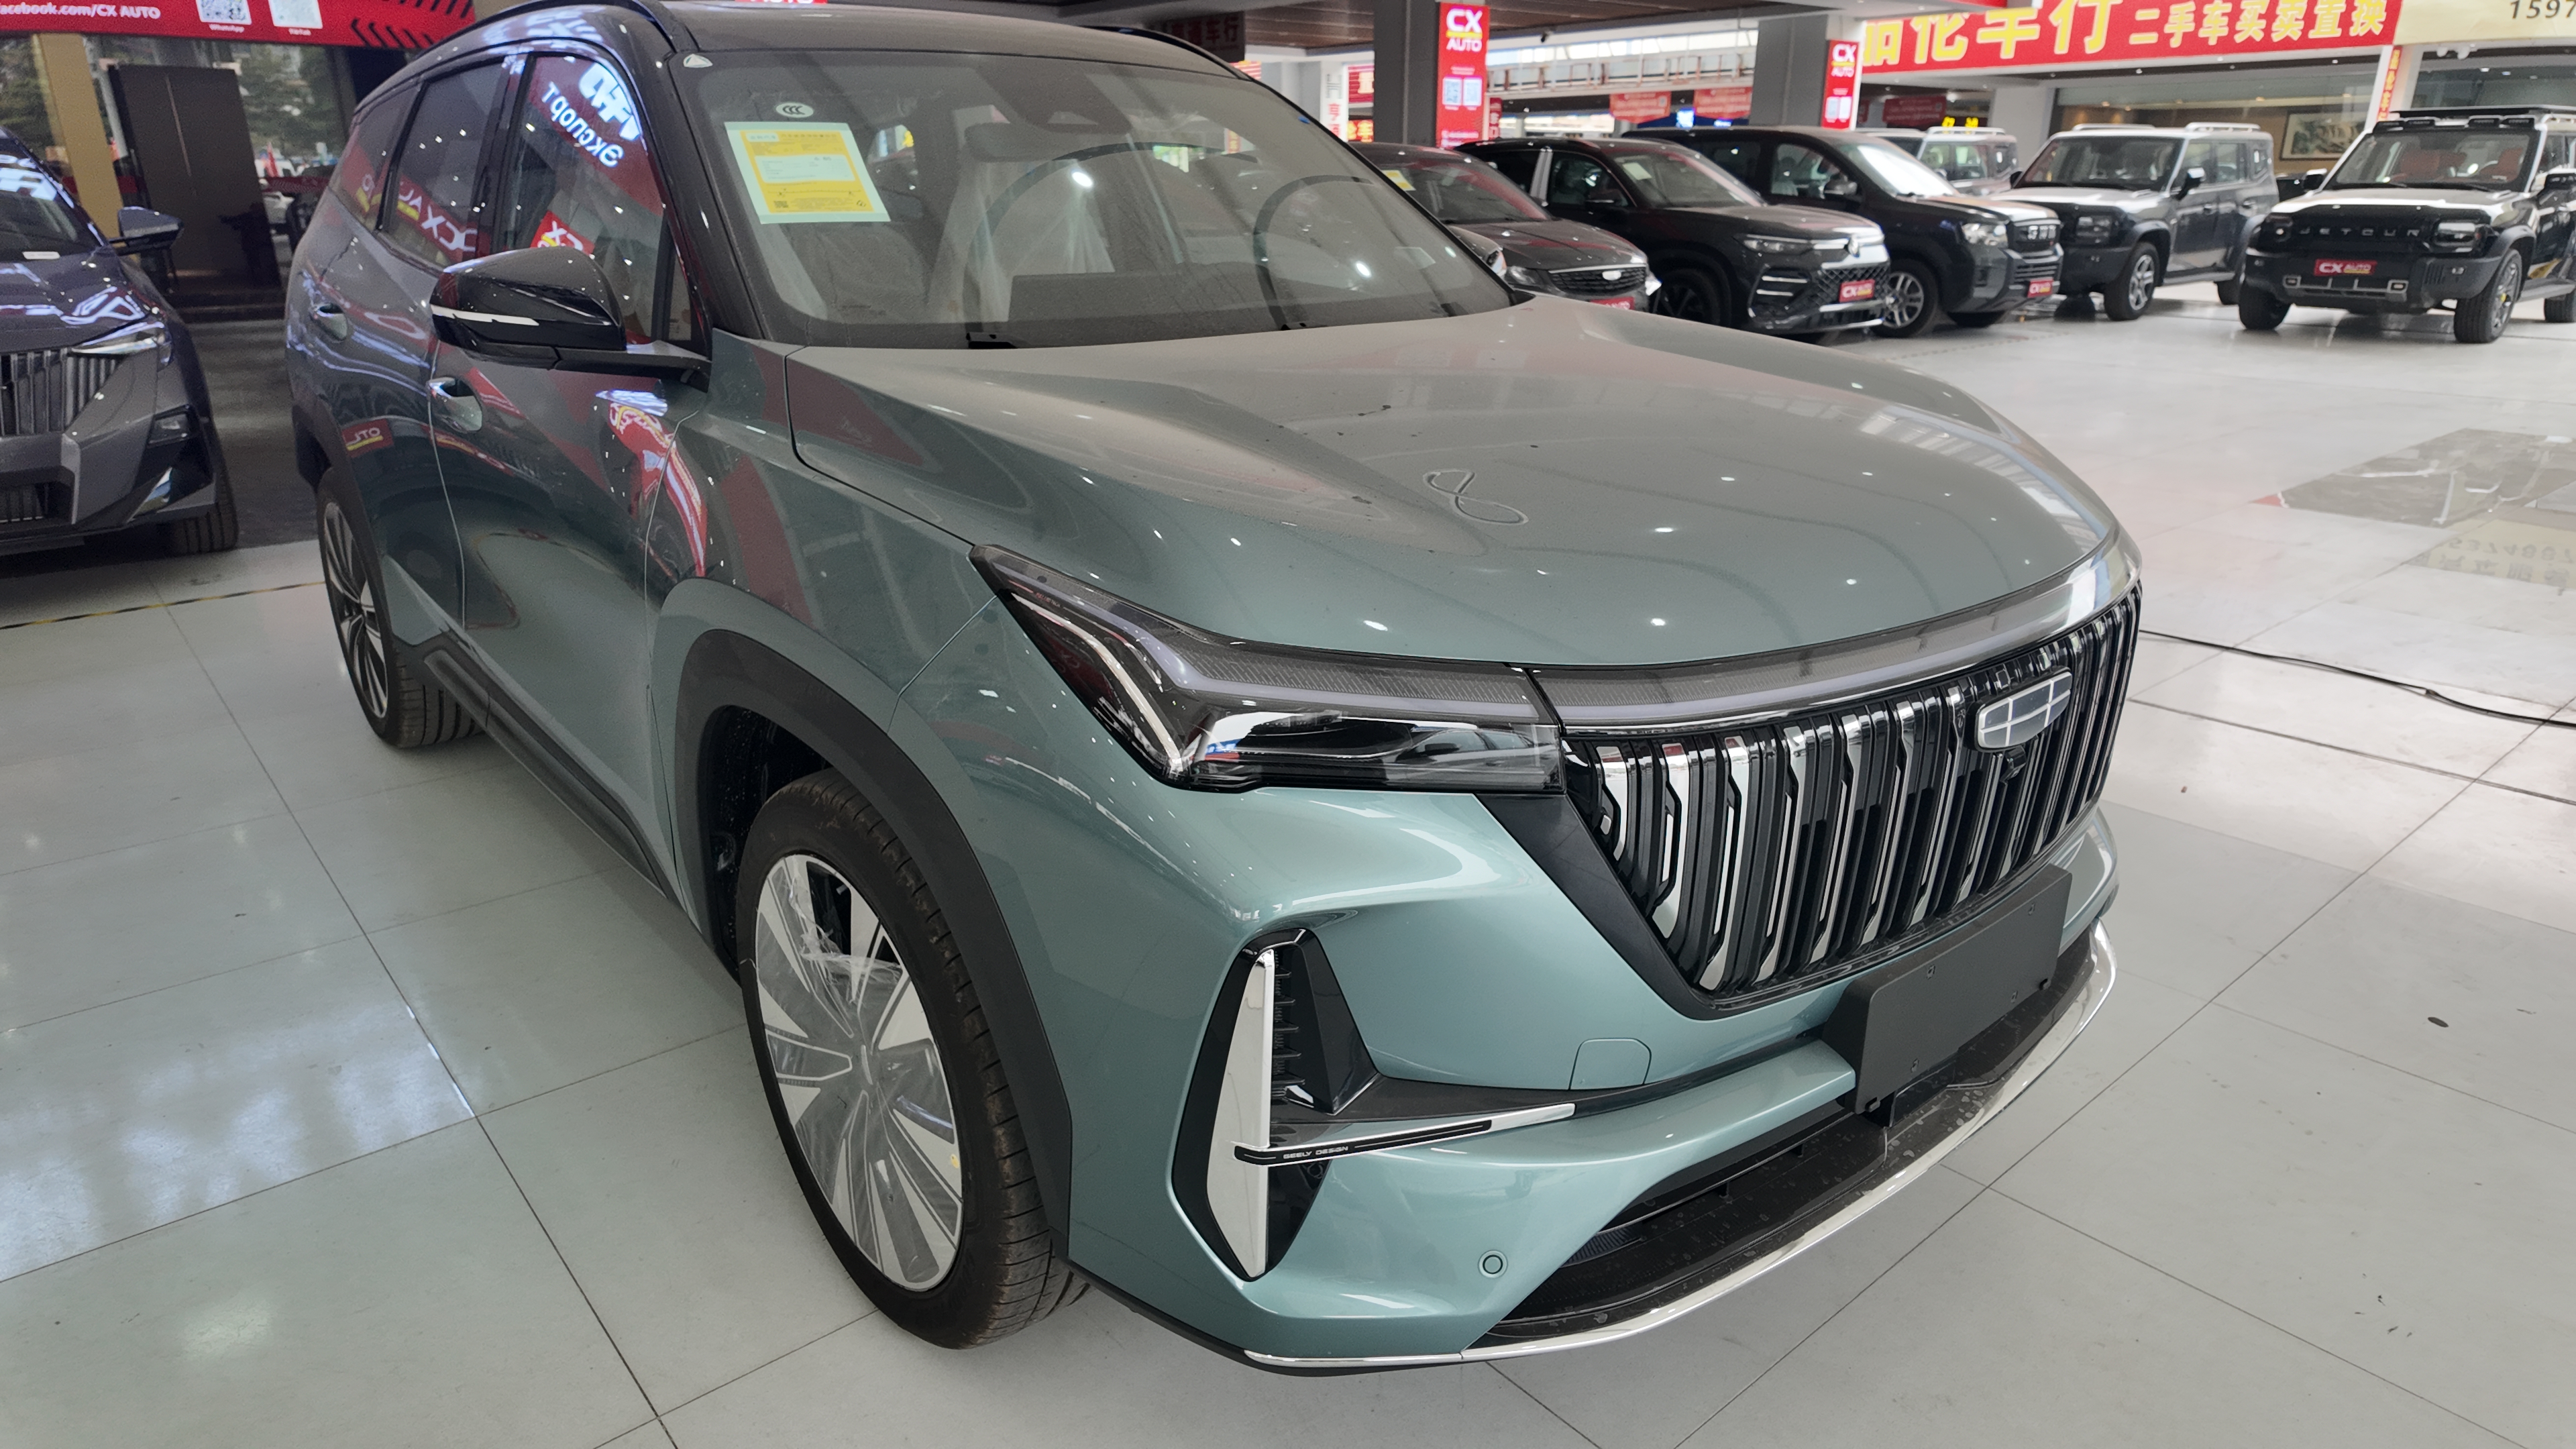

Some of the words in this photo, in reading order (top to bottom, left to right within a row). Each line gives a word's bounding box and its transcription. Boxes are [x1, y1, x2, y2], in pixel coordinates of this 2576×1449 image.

[0, 2, 117, 17] acebook.com/CX
[120, 5, 162, 19] AUTO
[1446, 8, 1483, 33] CX
[1446, 36, 1483, 52] AUTO
[1832, 43, 1857, 62] CX
[2298, 225, 2420, 237] JETOUR
[2318, 262, 2343, 274] CX
[2345, 264, 2372, 272] AUTO
[1283, 1151, 1312, 1159] GEELY
[1316, 1146, 1348, 1155] DESIGN
